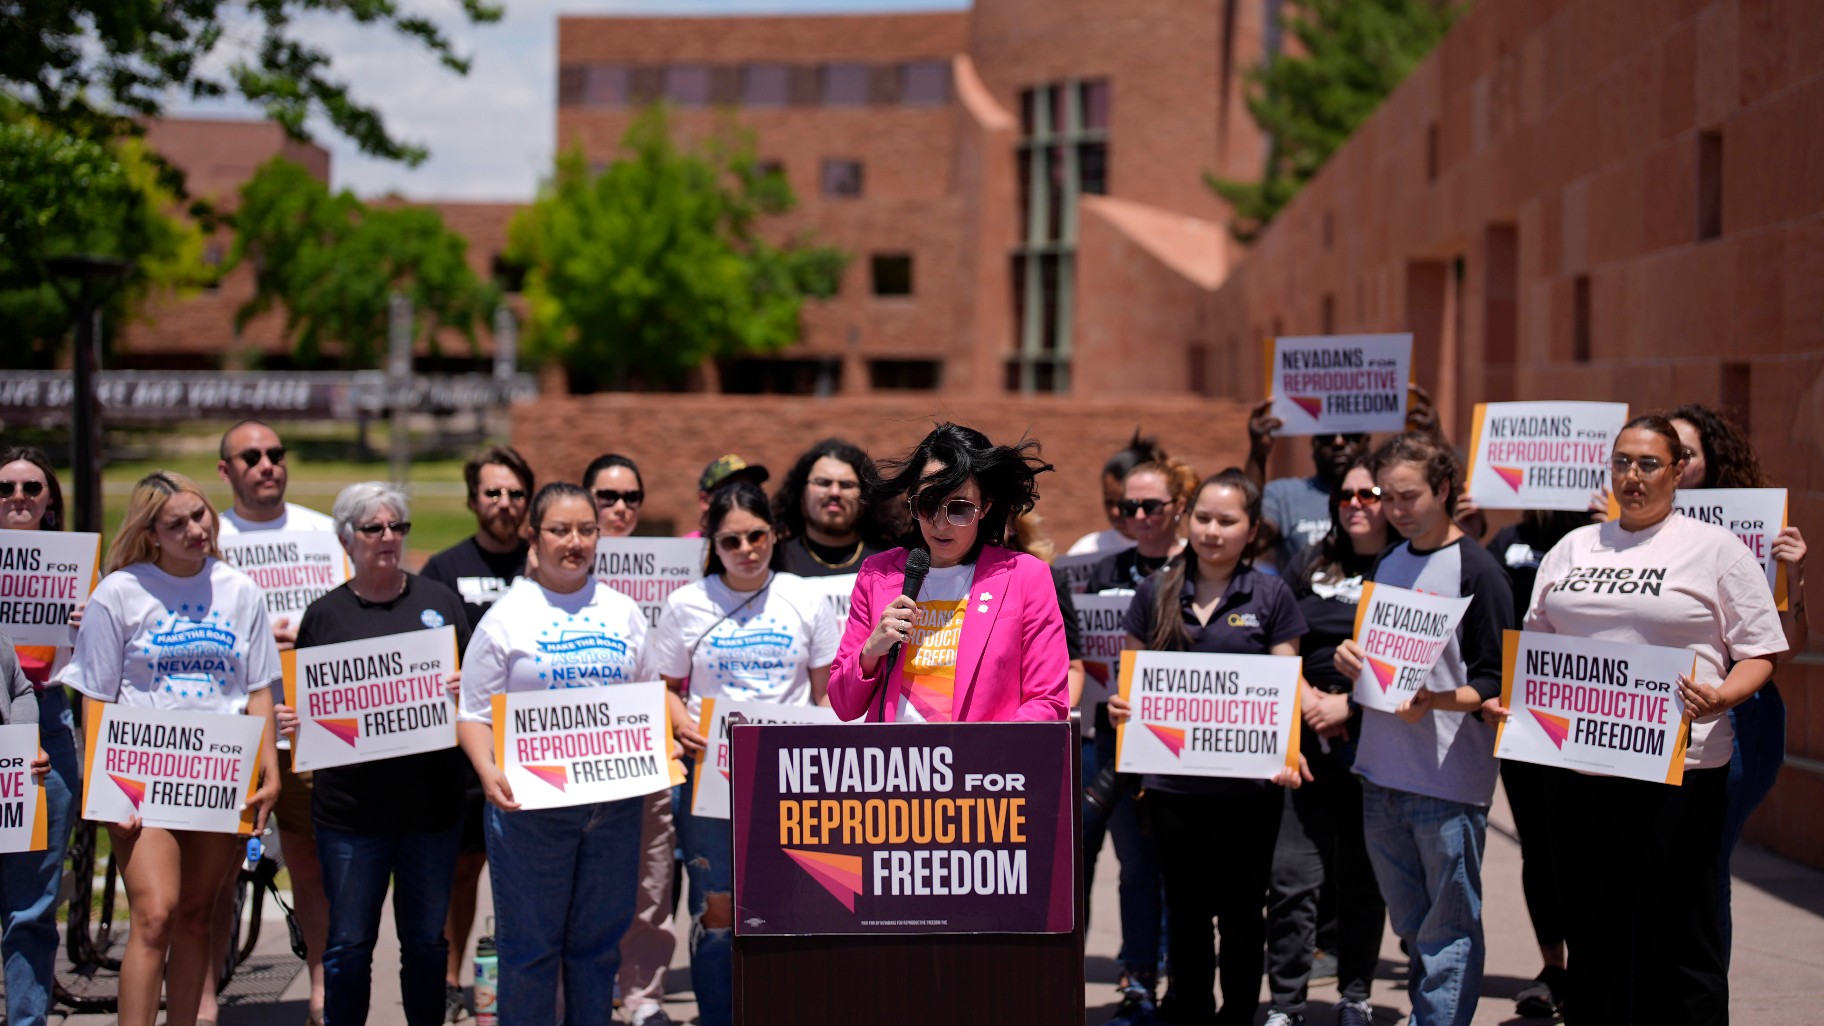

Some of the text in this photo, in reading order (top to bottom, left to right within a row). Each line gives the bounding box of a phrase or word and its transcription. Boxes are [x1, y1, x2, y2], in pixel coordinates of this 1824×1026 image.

[1282, 347, 1396, 370] NEVADANS FOR
[1283, 369, 1398, 392] REPRODUCTIVE
[1327, 393, 1399, 415] FREEDOM
[1490, 416, 1608, 439] NEVADANS FOR
[1487, 441, 1608, 464] REPRODUCTIVE
[1528, 466, 1606, 489] FREEDOM
[1730, 520, 1764, 530] FOR
[46, 563, 79, 572] FOR
[304, 552, 332, 562] FOR
[661, 566, 690, 576] FOR
[1638, 568, 1667, 581] IN
[1371, 601, 1449, 638] NEVADANS
[157, 629, 233, 645] MAKE THE ROAD
[547, 637, 625, 651] MAKE THE ROAD
[159, 643, 231, 660] ACTION
[551, 648, 625, 666] ACTION
[718, 659, 784, 671] NEVADA
[157, 660, 226, 672] NEVADA
[305, 651, 441, 689] NEVADANS FOR
[552, 666, 622, 681] NEVADA
[1526, 649, 1671, 693] NEVADANS FOR
[308, 673, 445, 717] REPRODUCTIVE
[1142, 668, 1240, 695] NEVADANS
[1245, 687, 1280, 697] FOR
[1141, 696, 1279, 725] REPRODUCTIVE
[1525, 679, 1670, 725] REPRODUCTIVE
[364, 702, 448, 737] FREEDOM
[514, 702, 650, 733] NEVADANS FOR
[107, 720, 243, 754] NEVADANS FOR
[516, 727, 654, 763] REPRODUCTIVE
[1192, 727, 1278, 755] FREEDOM
[1574, 717, 1666, 757] FREEDOM
[105, 747, 241, 782] REPRODUCTIVE
[571, 755, 659, 784] FREEDOM
[778, 746, 1027, 794] NEVADANS FOR
[151, 781, 238, 810] FREEDOM
[779, 797, 1027, 845] REPRODUCTIVE
[873, 849, 1028, 896] FREEDOM
